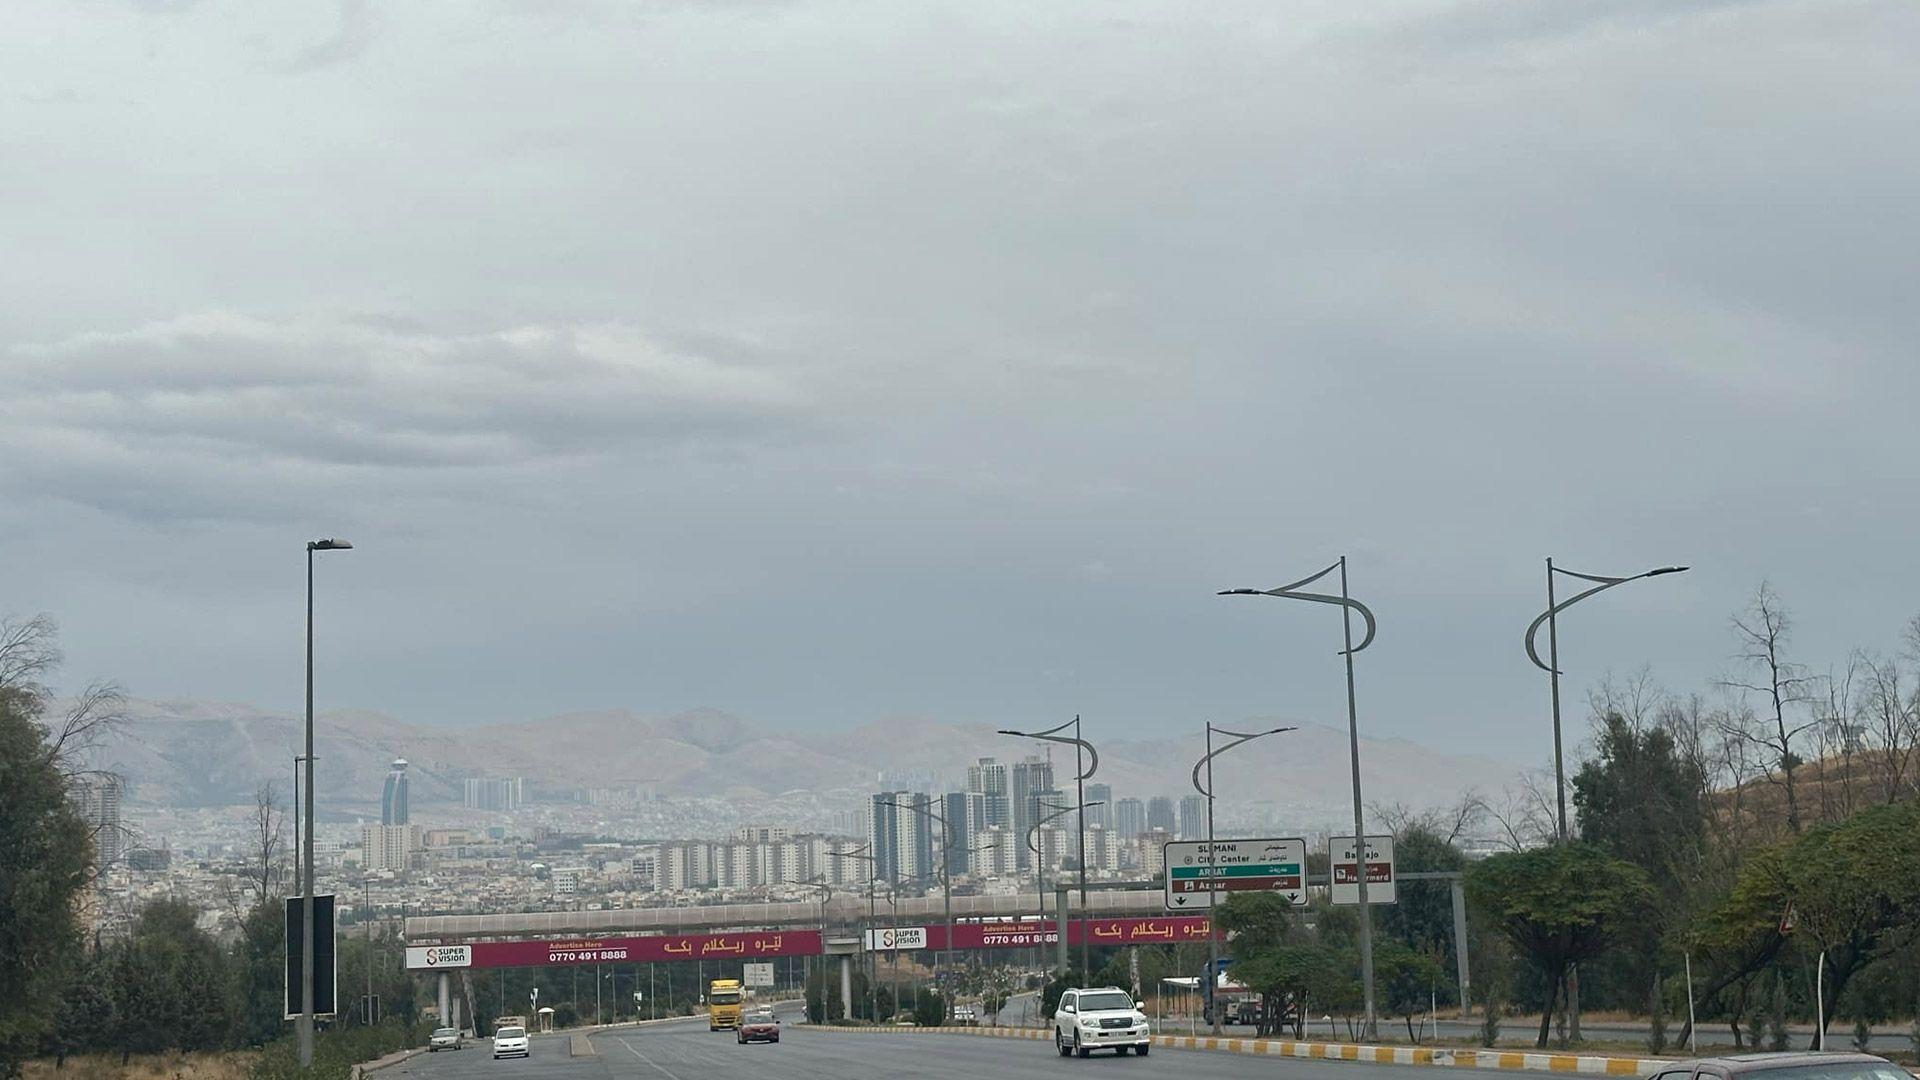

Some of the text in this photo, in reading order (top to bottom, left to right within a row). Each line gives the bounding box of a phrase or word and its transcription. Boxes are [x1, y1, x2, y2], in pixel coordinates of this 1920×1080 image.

[1198, 844, 1237, 853] SLMANI
[1221, 855, 1250, 863] Center
[1345, 851, 1379, 860] Baajo
[983, 935, 1009, 944] 0770
[1011, 934, 1030, 943] 491
[438, 947, 465, 955] SUPER
[549, 950, 627, 962] 0770 491 8888
